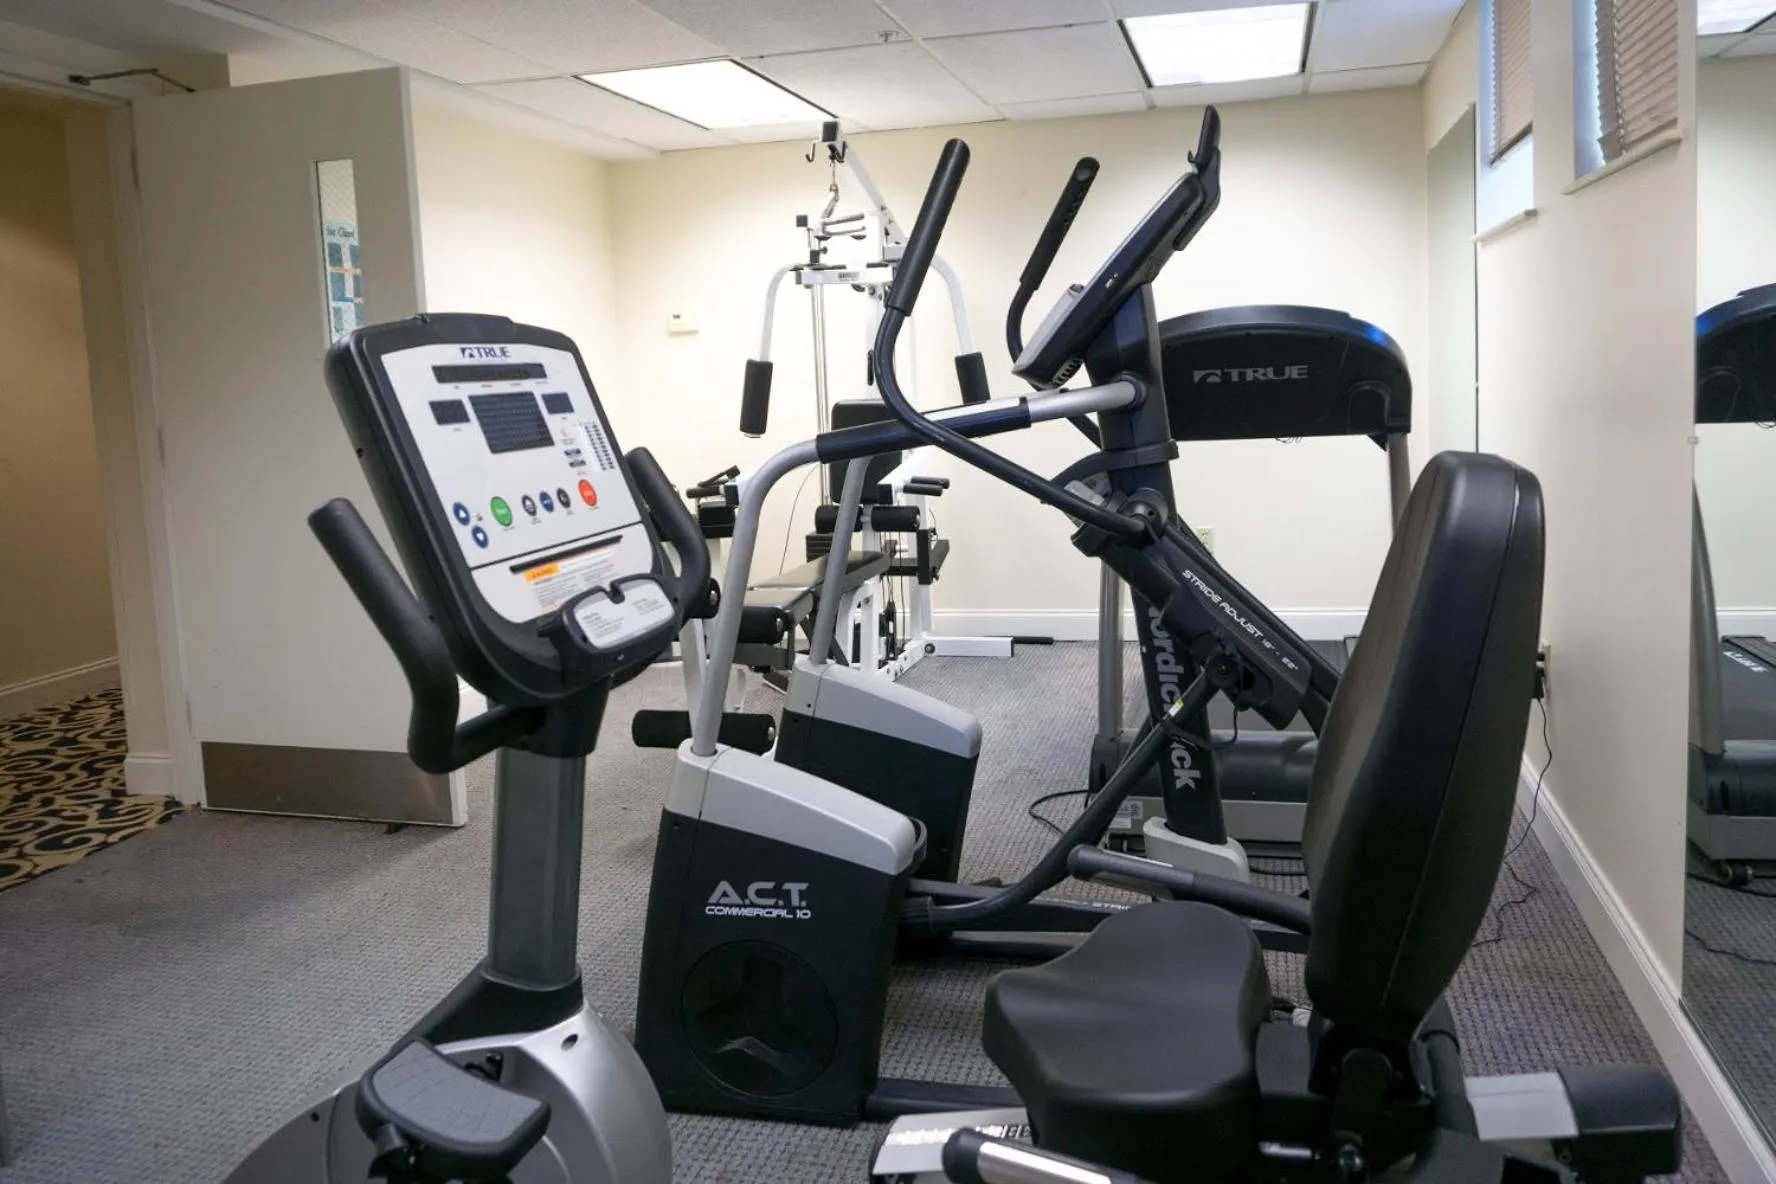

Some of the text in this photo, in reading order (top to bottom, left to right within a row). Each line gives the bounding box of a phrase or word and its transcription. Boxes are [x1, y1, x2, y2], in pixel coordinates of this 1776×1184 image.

[474, 346, 511, 359] TRUE
[1223, 364, 1309, 382] TRUE
[1181, 568, 1222, 604] STRIDE
[1218, 601, 1264, 638] ADJUST
[707, 879, 810, 907] A.C.T.
[704, 905, 812, 919] COMMERCIAL 10
